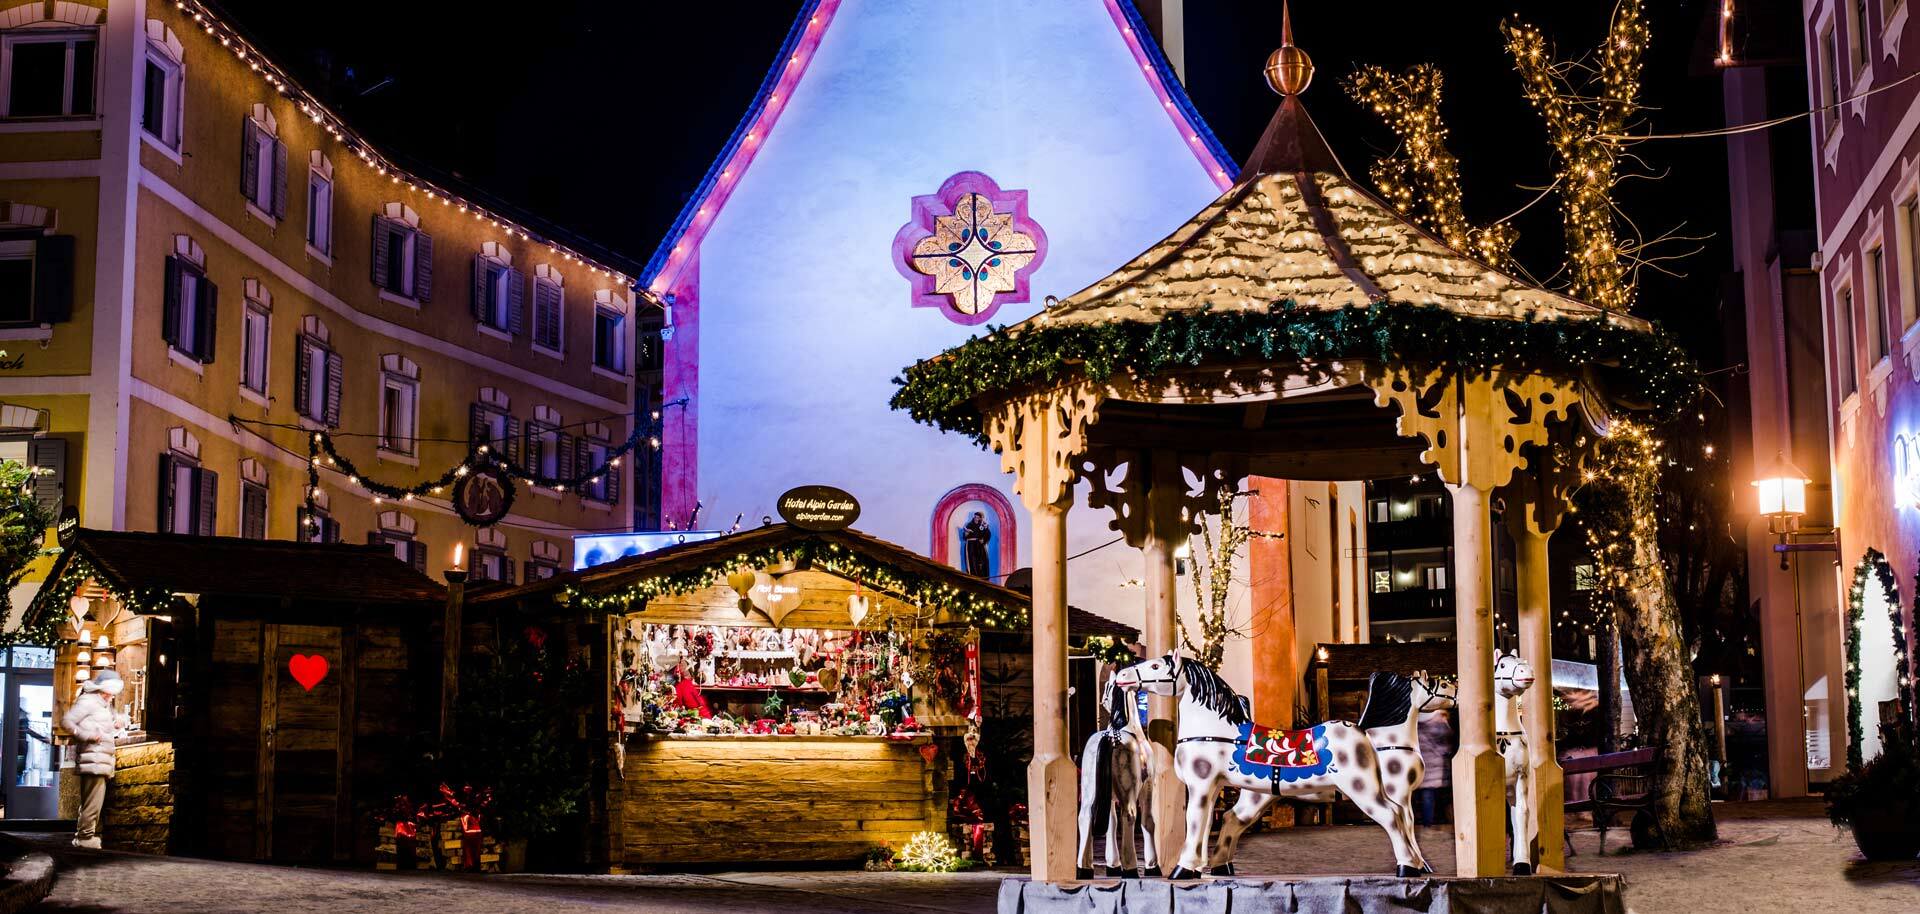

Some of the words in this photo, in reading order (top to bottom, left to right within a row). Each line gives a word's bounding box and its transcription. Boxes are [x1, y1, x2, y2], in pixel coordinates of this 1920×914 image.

[785, 498, 807, 509] Hotel
[806, 499, 826, 511] Alpin
[827, 500, 854, 510] Garden
[796, 512, 844, 522] alpingarden.com
